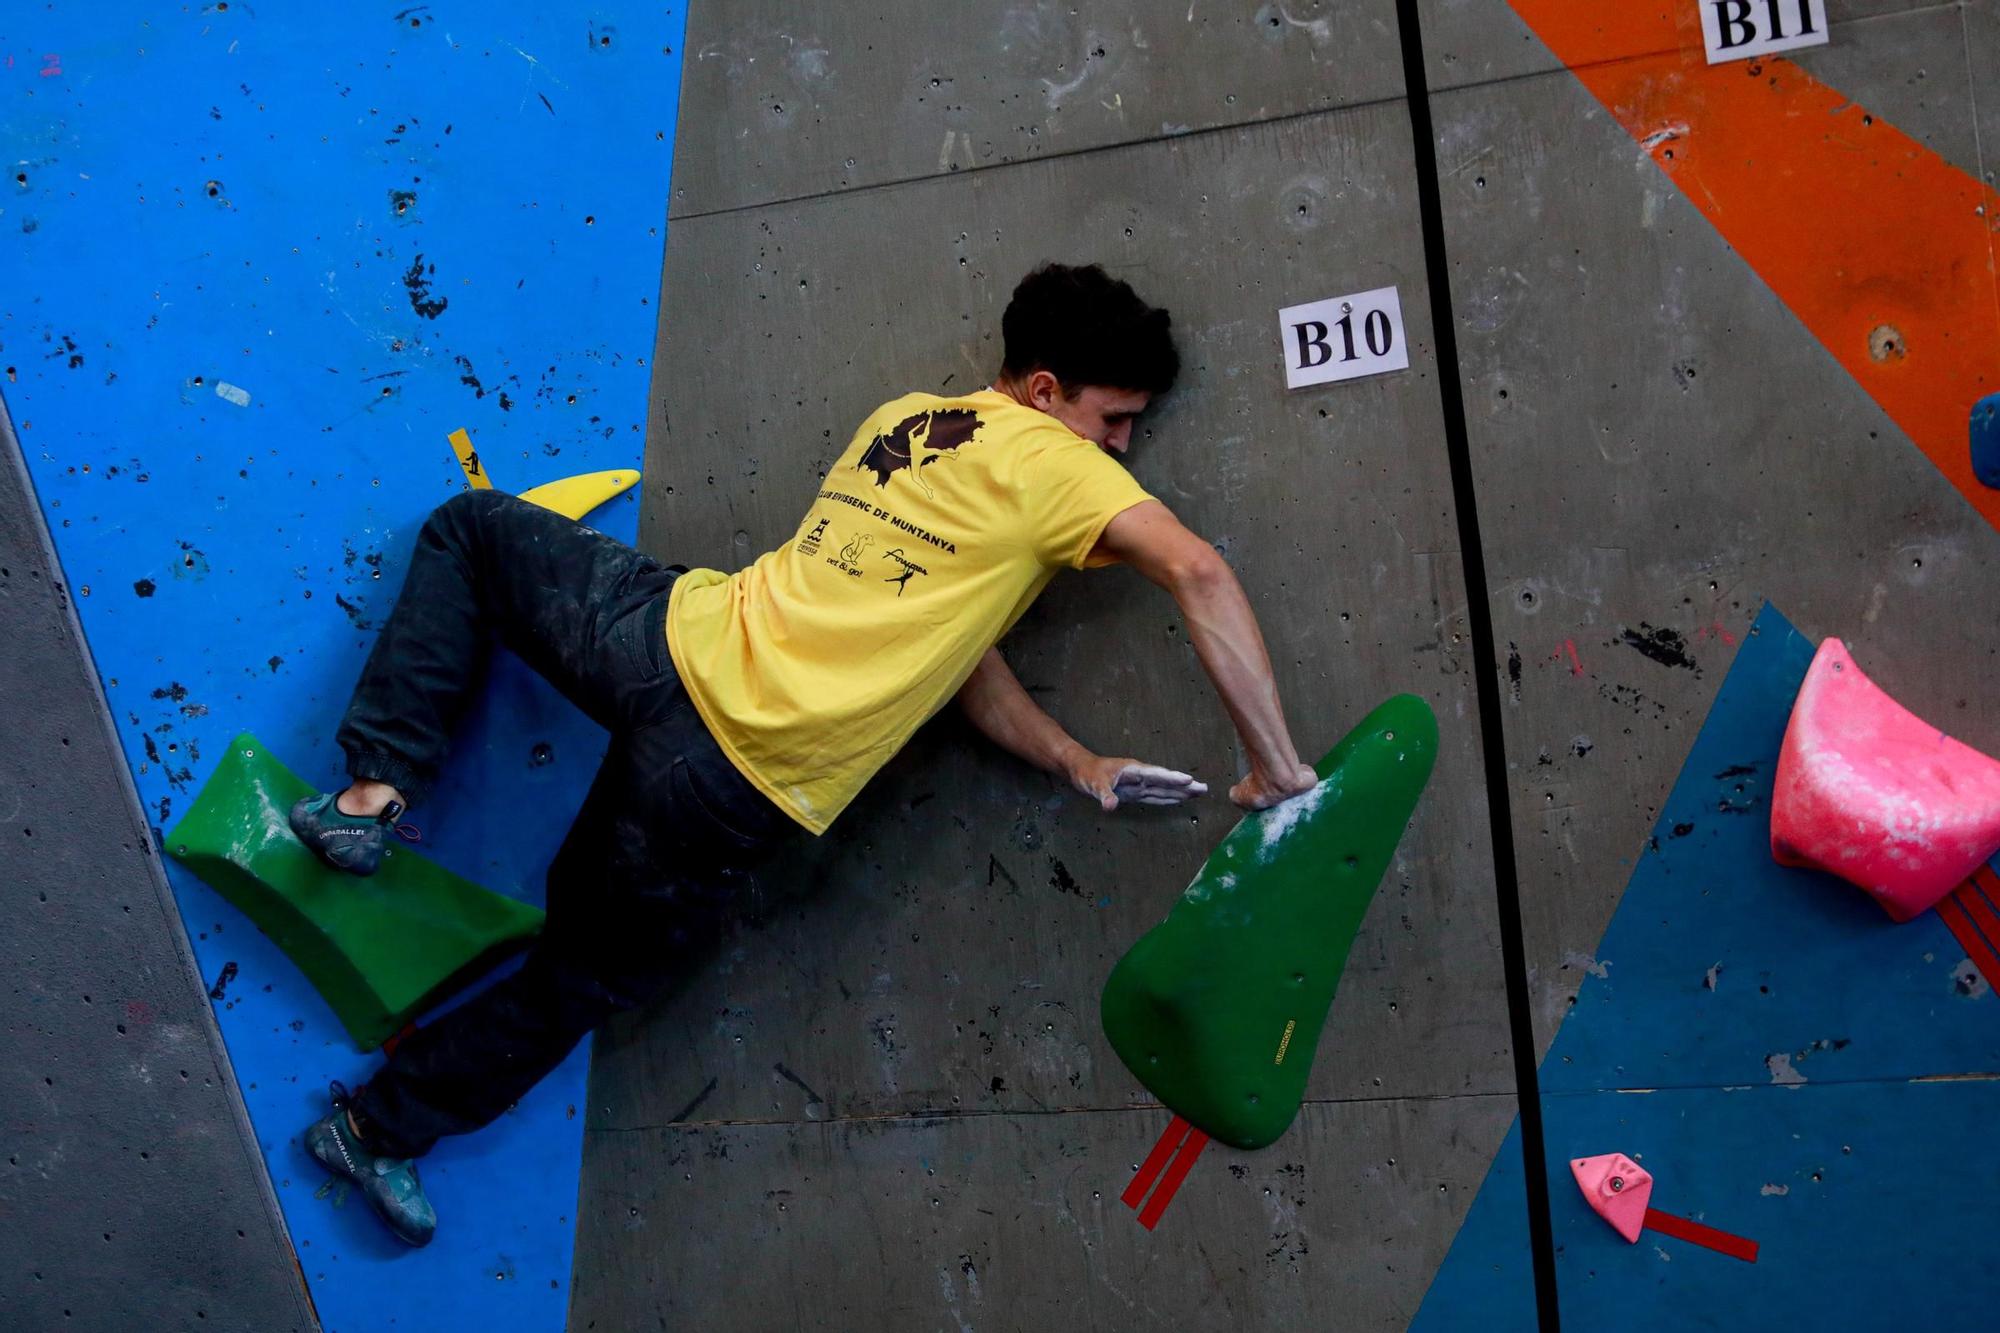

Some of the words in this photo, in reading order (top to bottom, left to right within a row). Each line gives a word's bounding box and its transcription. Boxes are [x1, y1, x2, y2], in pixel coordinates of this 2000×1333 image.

[1710, 0, 1819, 50] B11
[1290, 309, 1393, 370] B10
[819, 490, 833, 499] CLUB
[832, 492, 872, 512] EIVISSENC
[873, 508, 890, 521] DE
[890, 516, 957, 555] MUNTANYA
[826, 557, 839, 567] vet
[839, 561, 848, 571] &
[848, 567, 863, 578] go!
[328, 1122, 356, 1174] UNPARALLEL
